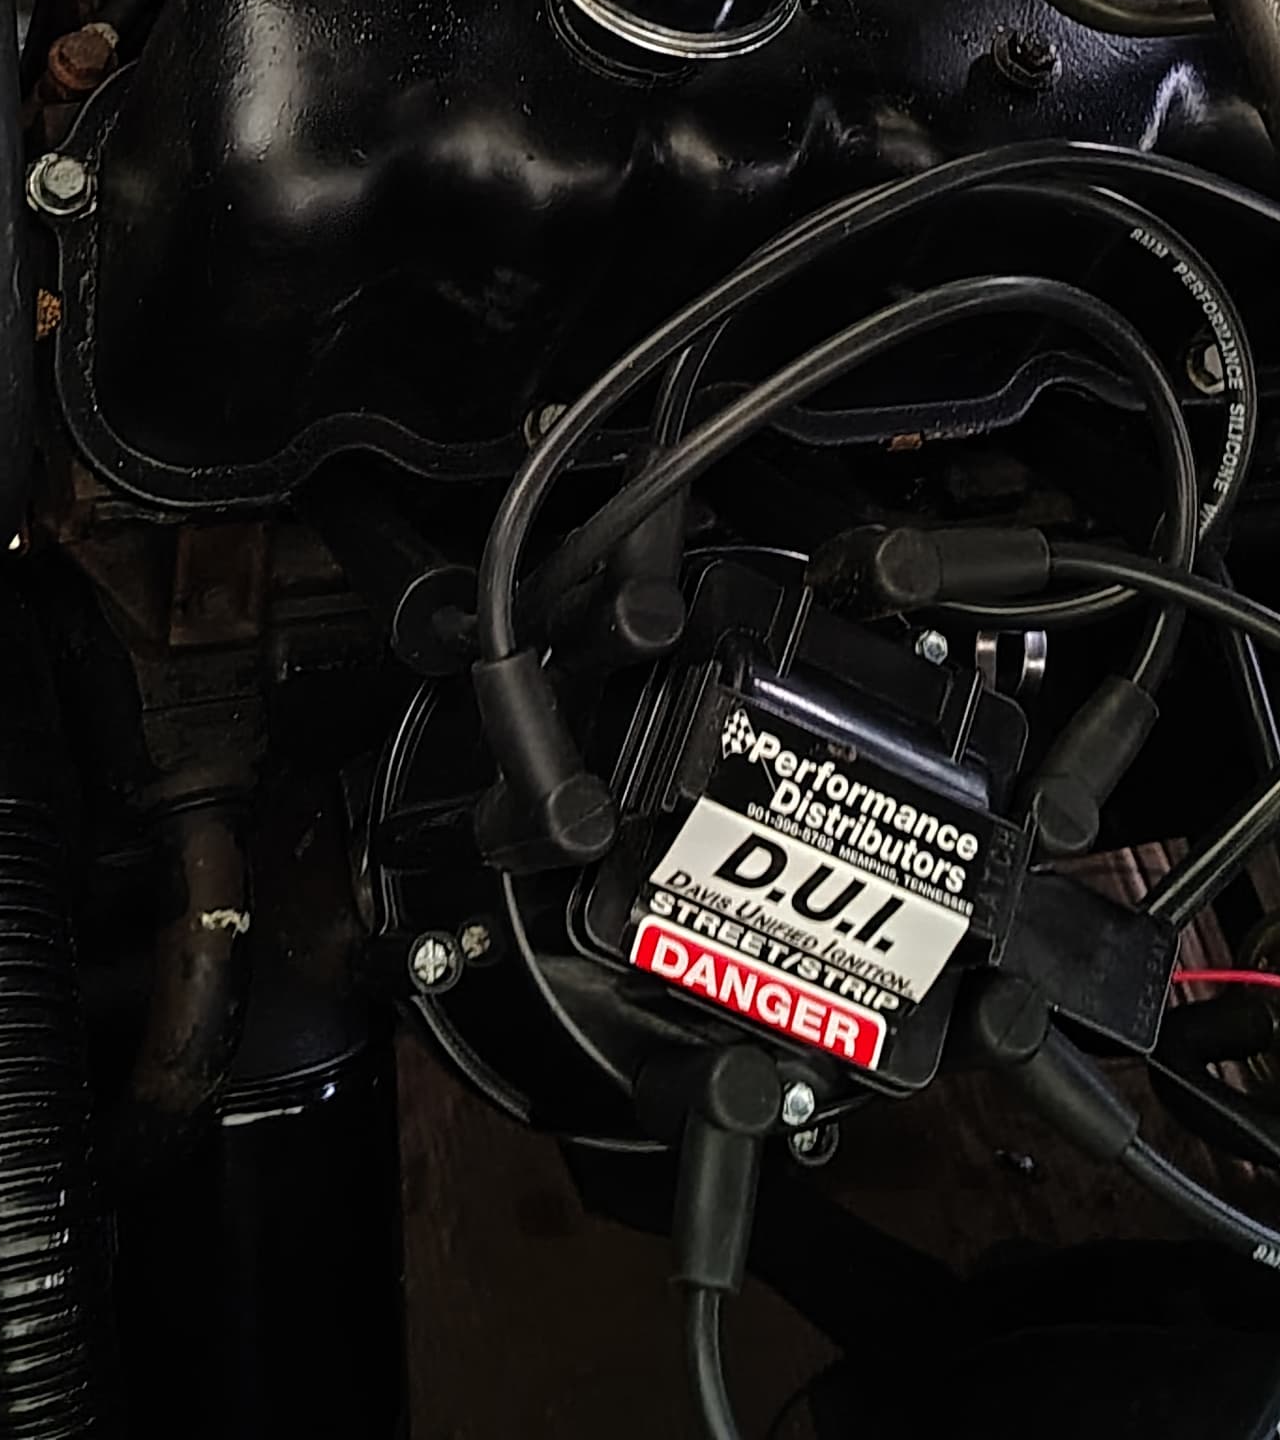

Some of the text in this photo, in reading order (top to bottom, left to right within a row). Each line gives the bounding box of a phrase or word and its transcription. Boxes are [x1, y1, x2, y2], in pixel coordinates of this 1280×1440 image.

[1171, 260, 1243, 391] PERFORMANCE
[1212, 403, 1243, 494] SILICONE
[749, 731, 979, 861] Performance
[771, 778, 967, 892] Distributors
[648, 890, 900, 1012] STREET/STRIP
[665, 871, 911, 990] DAVIS UNIFIED IGNITION
[714, 832, 907, 953] D.U.I.
[650, 933, 861, 1057] DANGER
